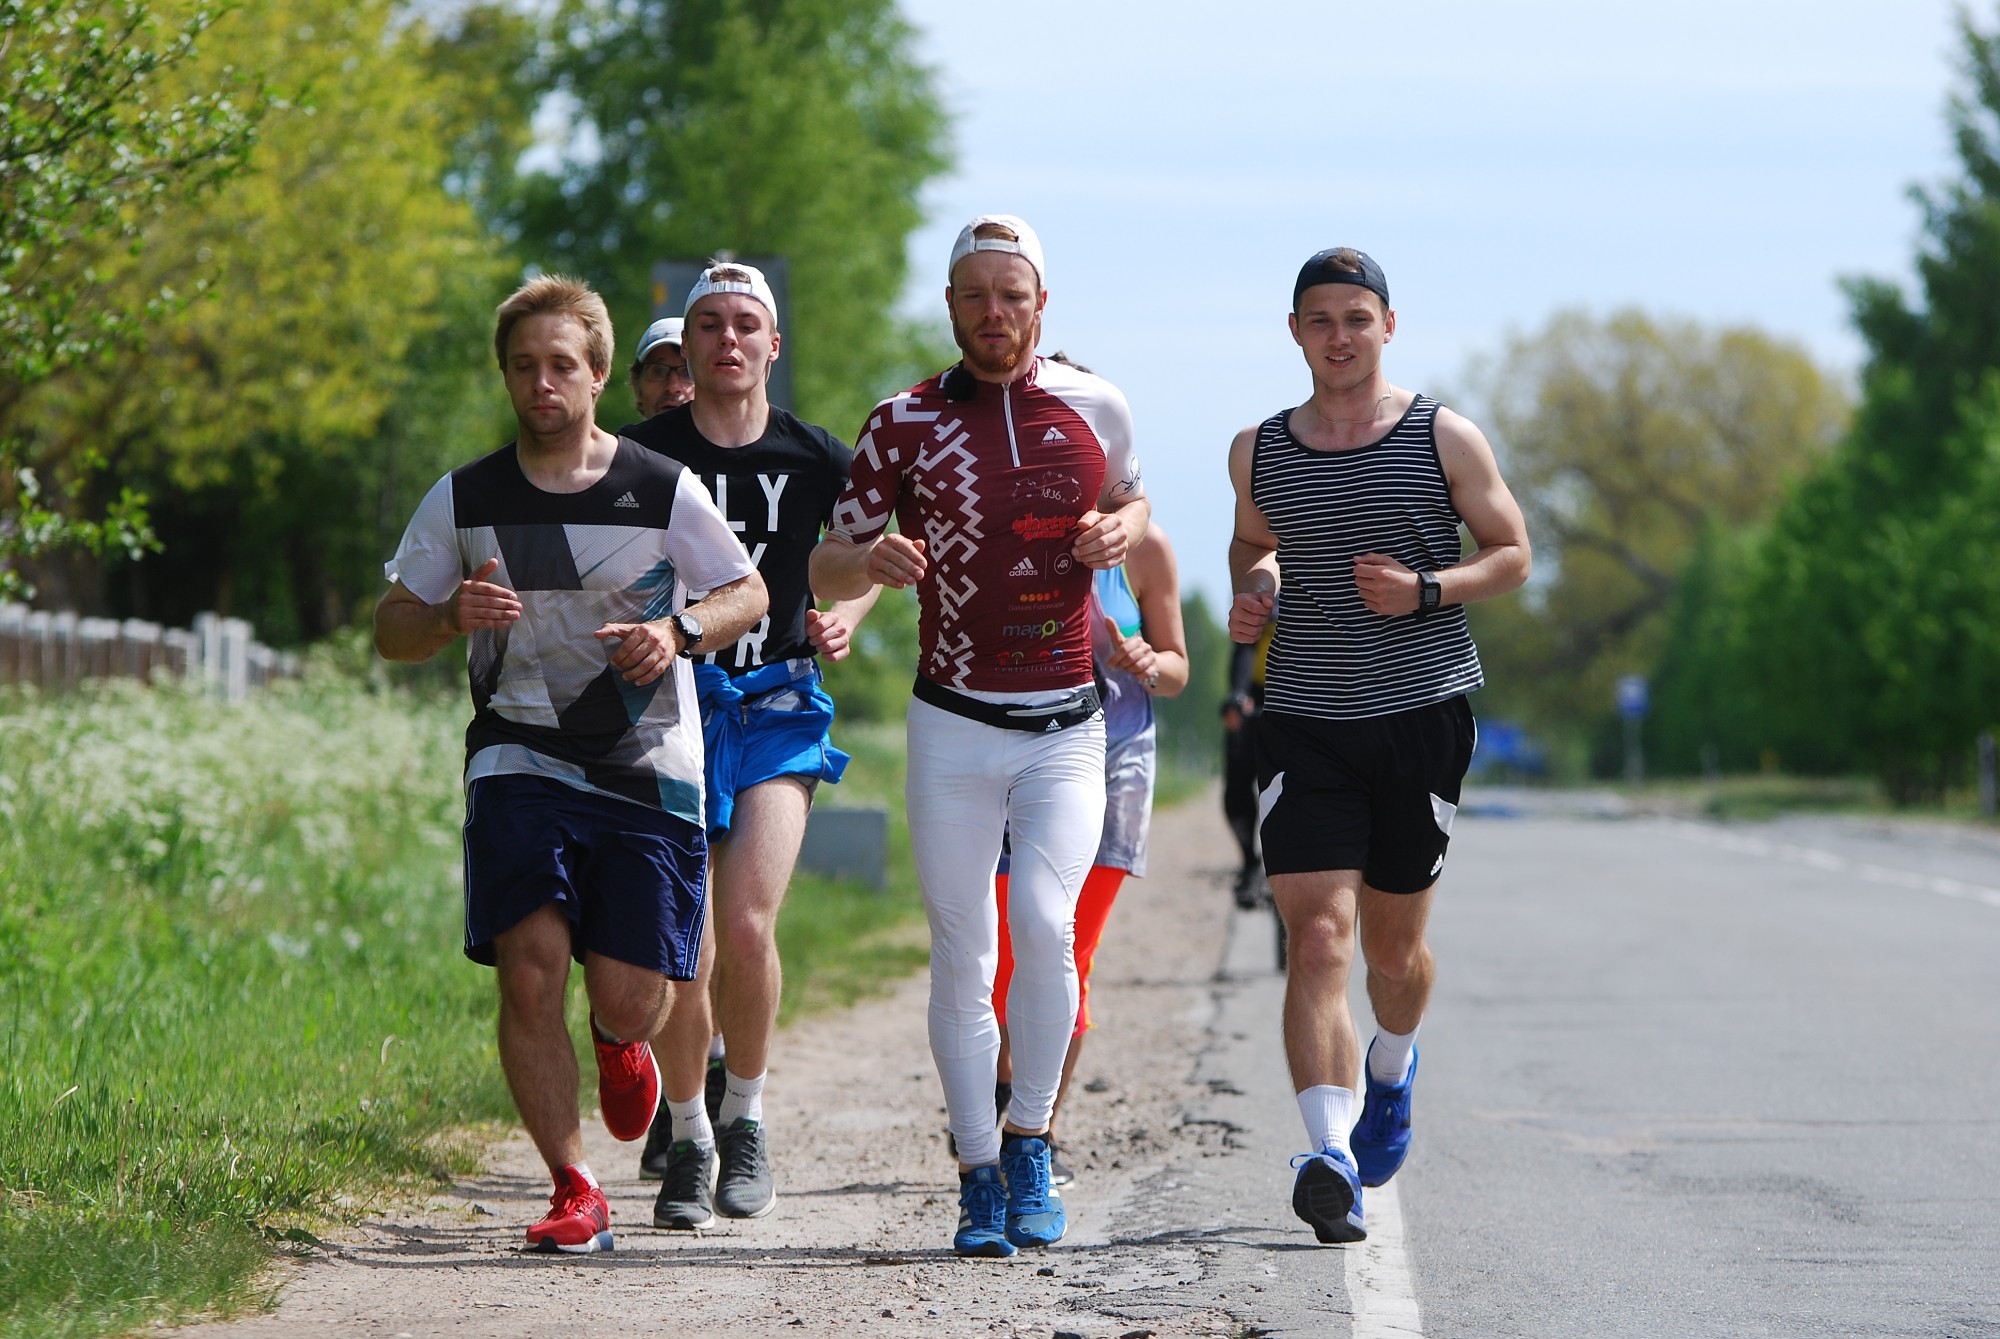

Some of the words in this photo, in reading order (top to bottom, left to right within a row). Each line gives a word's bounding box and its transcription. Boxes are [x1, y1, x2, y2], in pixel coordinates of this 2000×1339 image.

[694, 473, 790, 532] LY
[1041, 488, 1062, 500] 1836
[1012, 512, 1078, 534] ghetto
[1008, 569, 1039, 577] adidas
[1002, 619, 1065, 640] mapon
